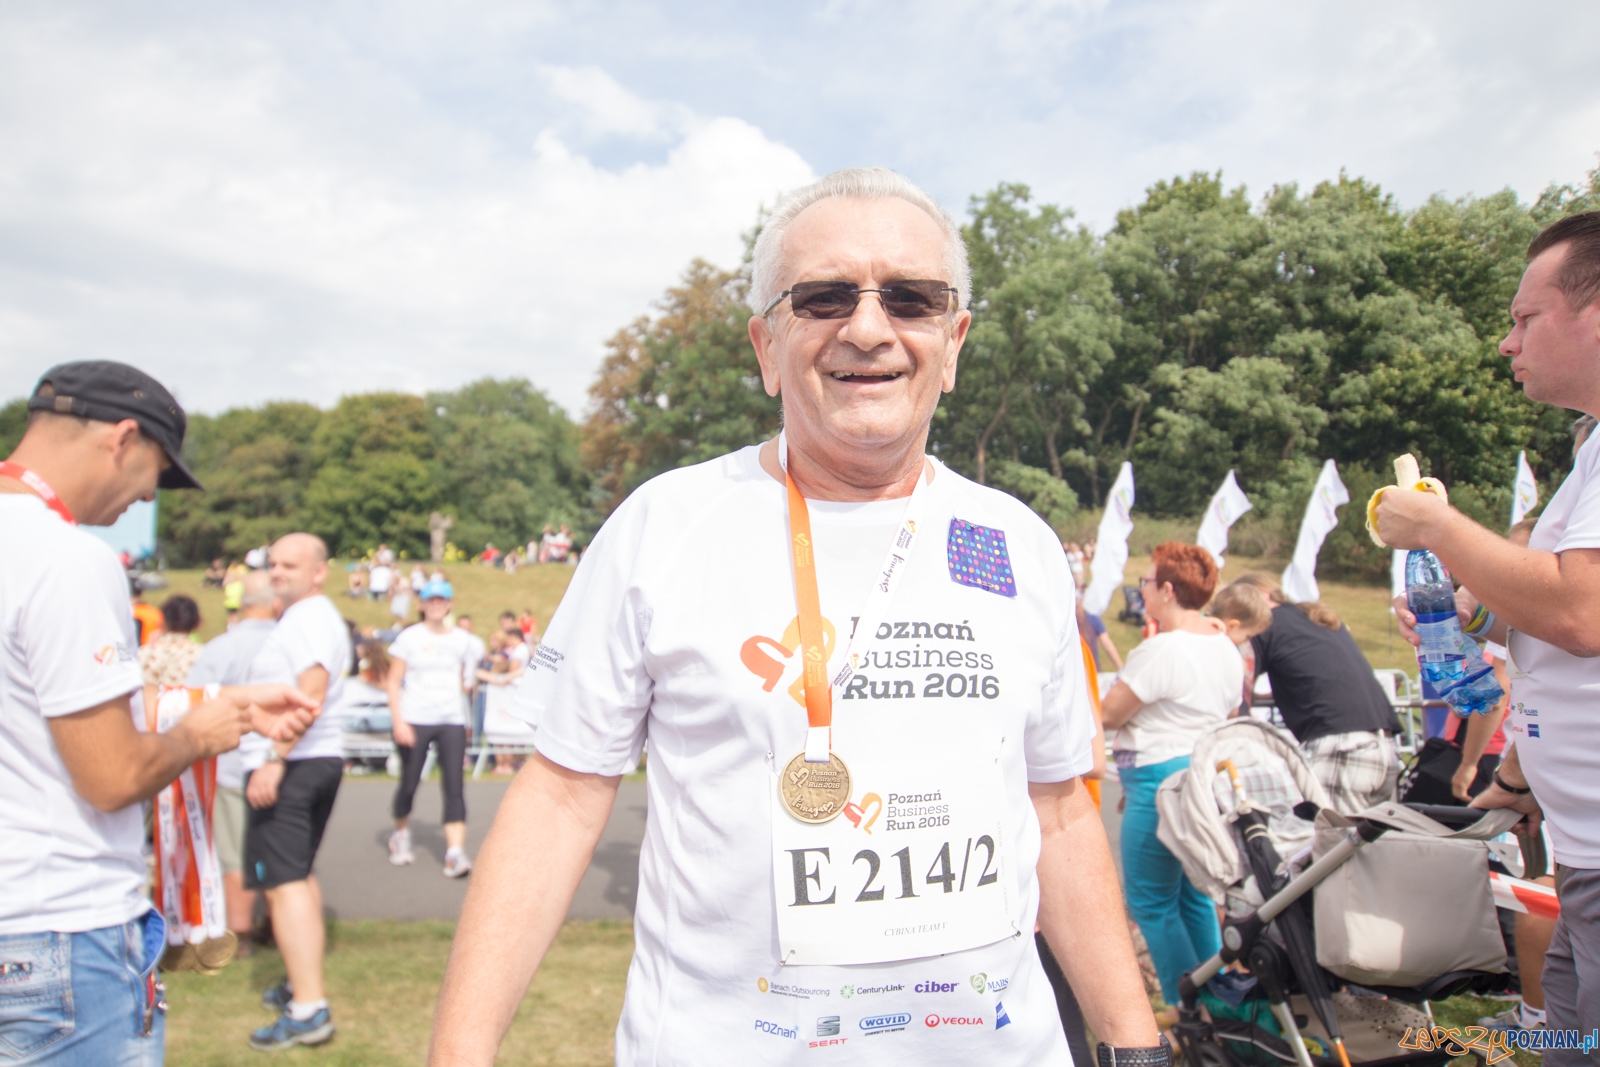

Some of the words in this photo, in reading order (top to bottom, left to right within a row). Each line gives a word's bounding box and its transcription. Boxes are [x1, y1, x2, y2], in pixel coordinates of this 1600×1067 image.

[535, 649, 558, 664] oland
[842, 674, 915, 700] Run
[923, 673, 1000, 700] 2016
[888, 789, 942, 805] Poznań
[887, 804, 949, 818] Business
[886, 819, 915, 831] Run
[918, 815, 950, 829] 2016
[784, 847, 837, 907] E
[852, 834, 998, 903] 214/2
[884, 926, 915, 937] CYBINA
[918, 922, 941, 933] TEAM
[857, 984, 903, 994] CenturyLink
[914, 980, 957, 993] ciber
[987, 978, 1009, 990] MARS
[791, 985, 830, 997] Outsourcing
[865, 1015, 906, 1027] wavin
[942, 1017, 984, 1025] VEOLIA
[808, 1038, 848, 1049] SEAT
